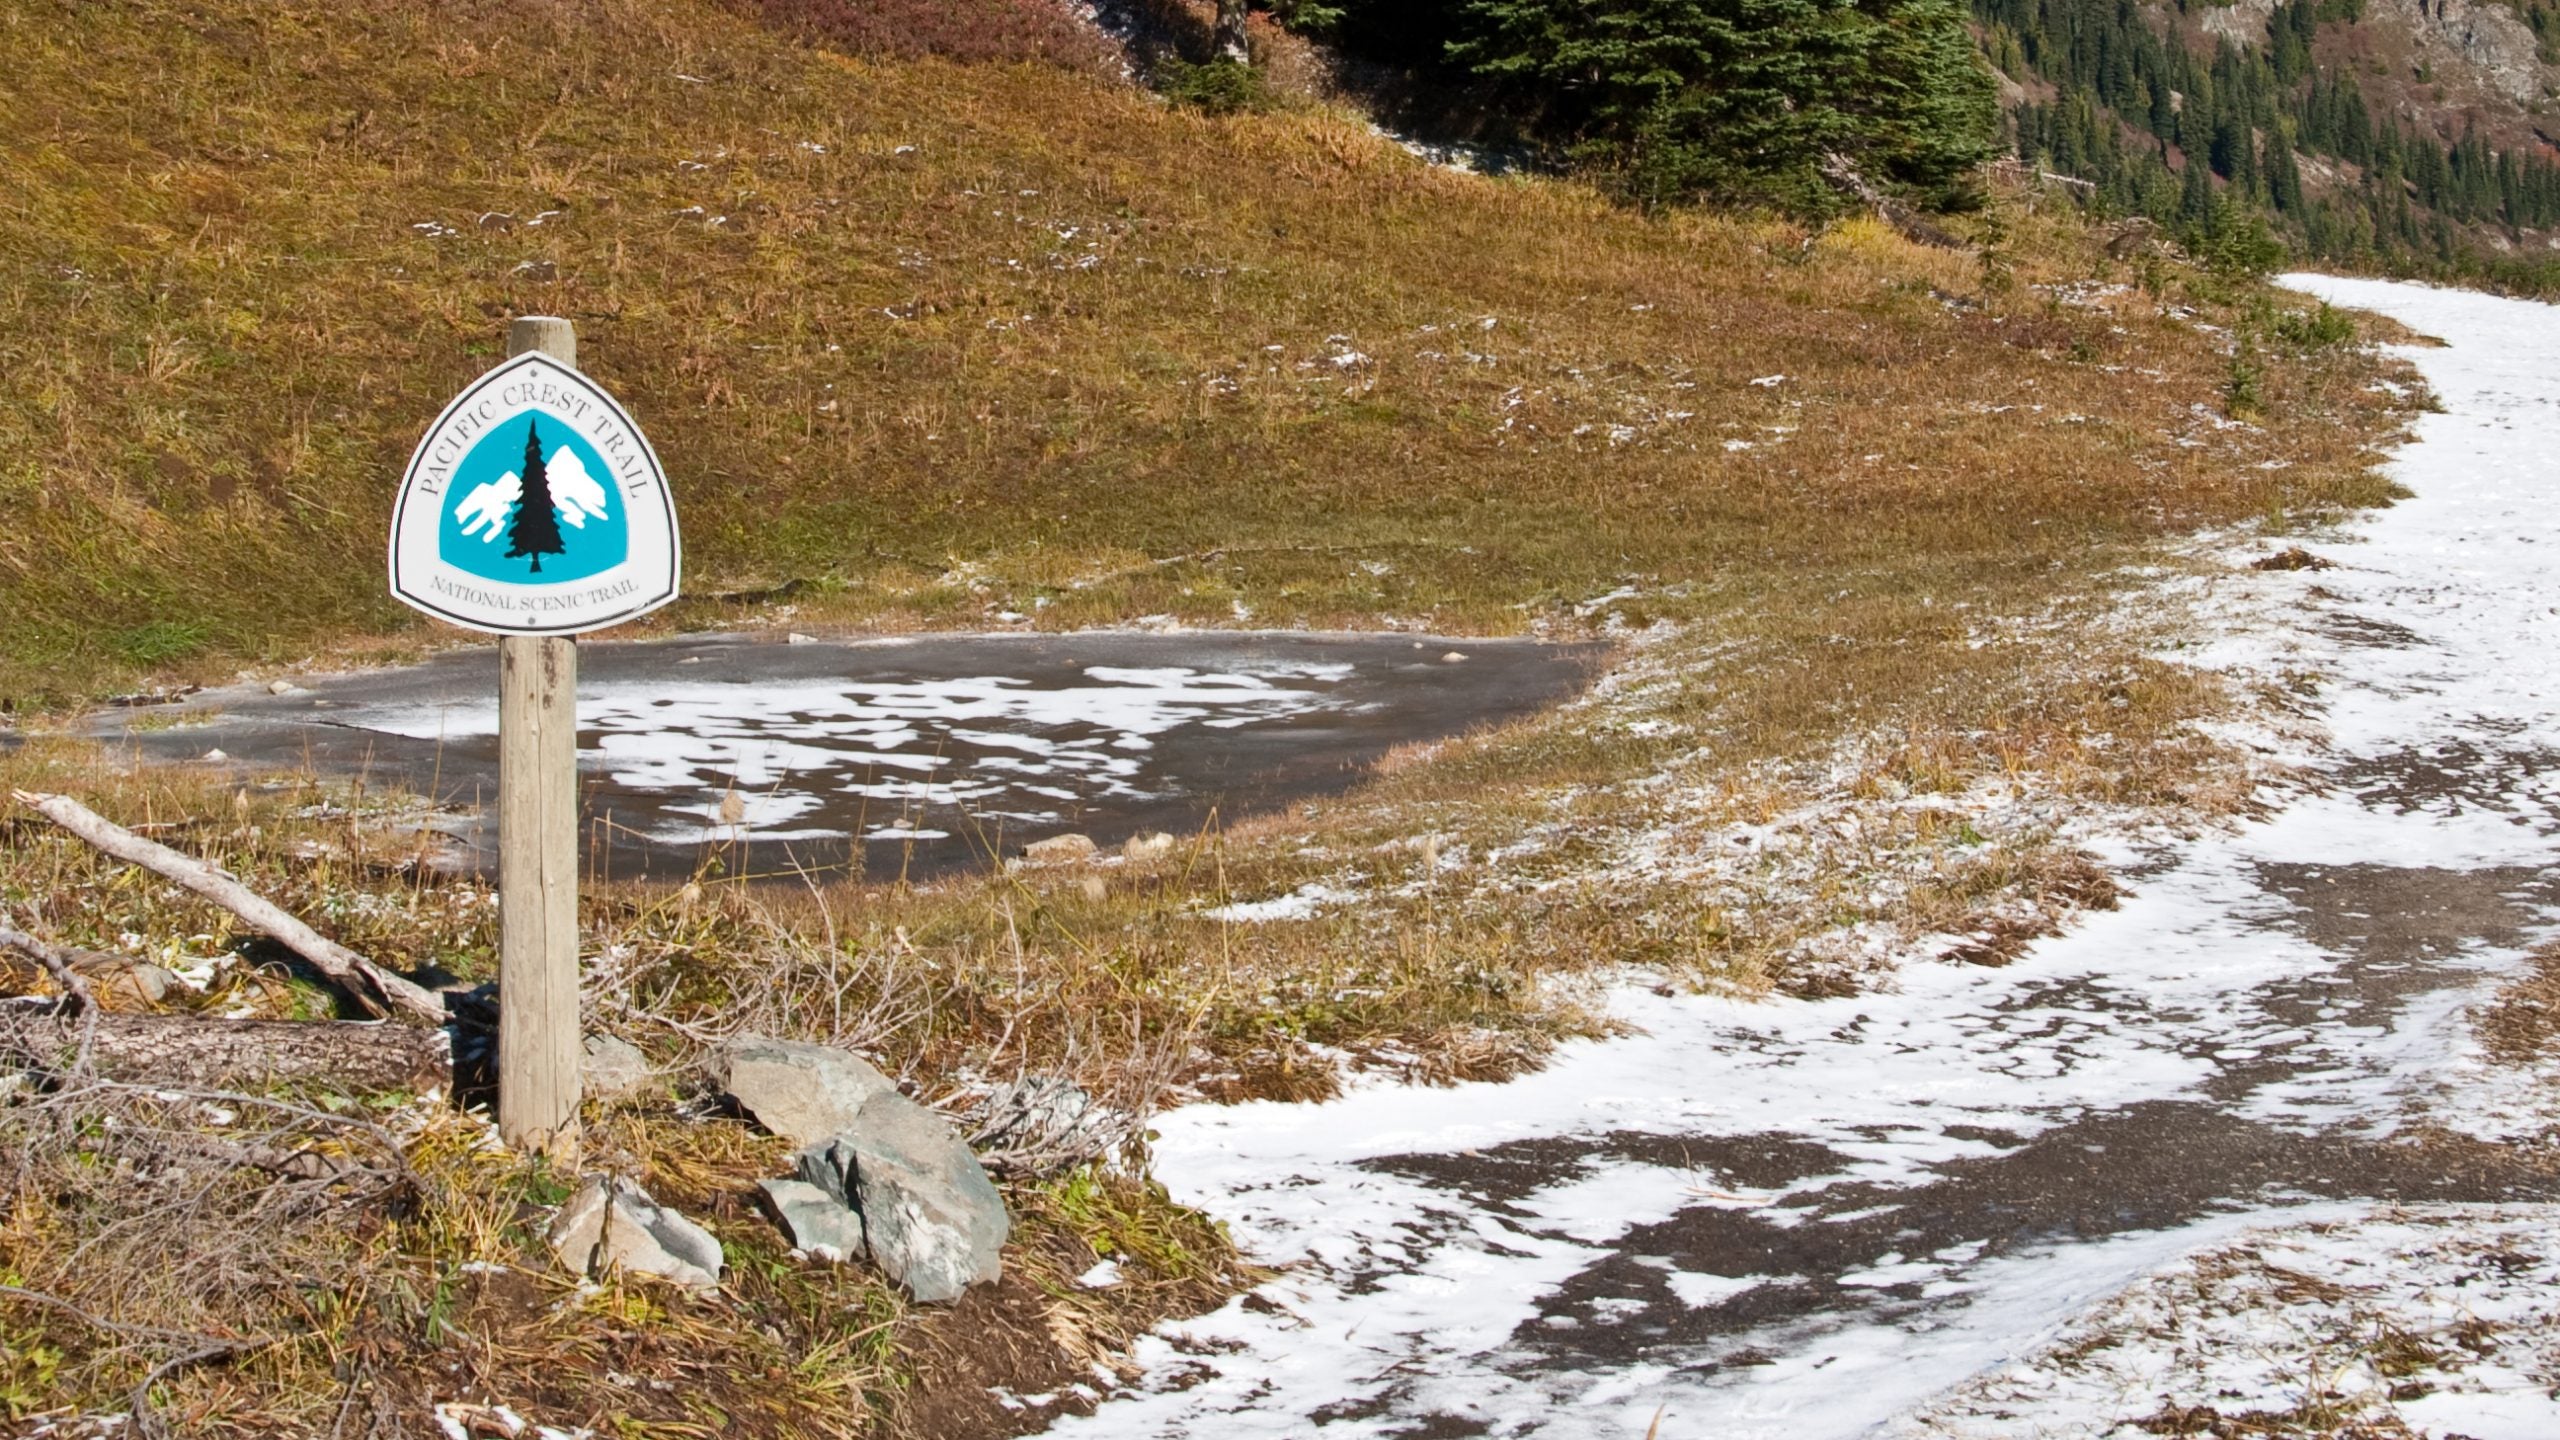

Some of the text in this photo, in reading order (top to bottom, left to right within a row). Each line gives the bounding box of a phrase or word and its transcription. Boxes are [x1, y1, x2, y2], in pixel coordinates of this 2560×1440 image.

[420, 382, 648, 498] PACIFIC CREST TRAIL
[430, 576, 639, 611] NATIONAL SCENIC TRAIL
